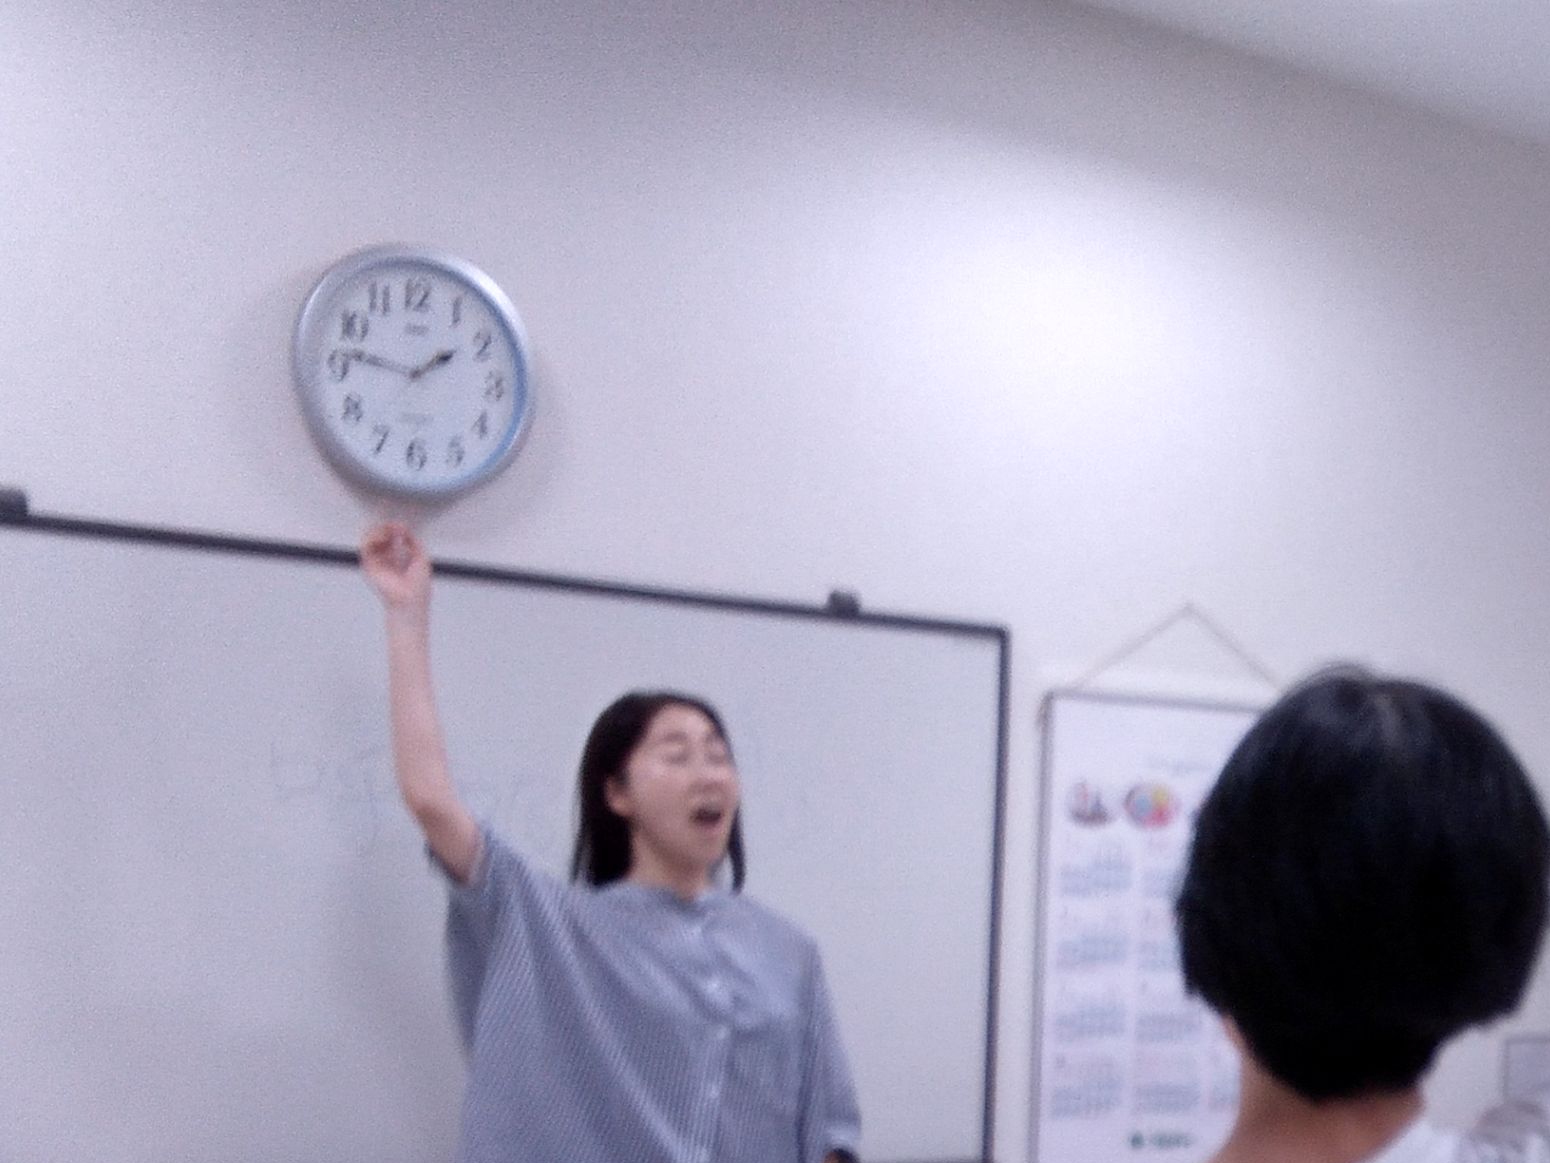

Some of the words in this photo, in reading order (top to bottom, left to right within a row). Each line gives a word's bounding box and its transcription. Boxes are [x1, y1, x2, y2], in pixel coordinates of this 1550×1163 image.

[368, 281, 390, 316] 11
[404, 279, 431, 313] 12
[341, 310, 369, 342] 10
[451, 297, 462, 328] 1
[473, 331, 492, 362] 2
[327, 349, 349, 381] 9
[485, 370, 504, 401] 3
[342, 392, 363, 425] 8
[371, 424, 390, 455] 7
[471, 411, 487, 439] 4
[406, 439, 427, 471] 6
[446, 435, 464, 467] 5
